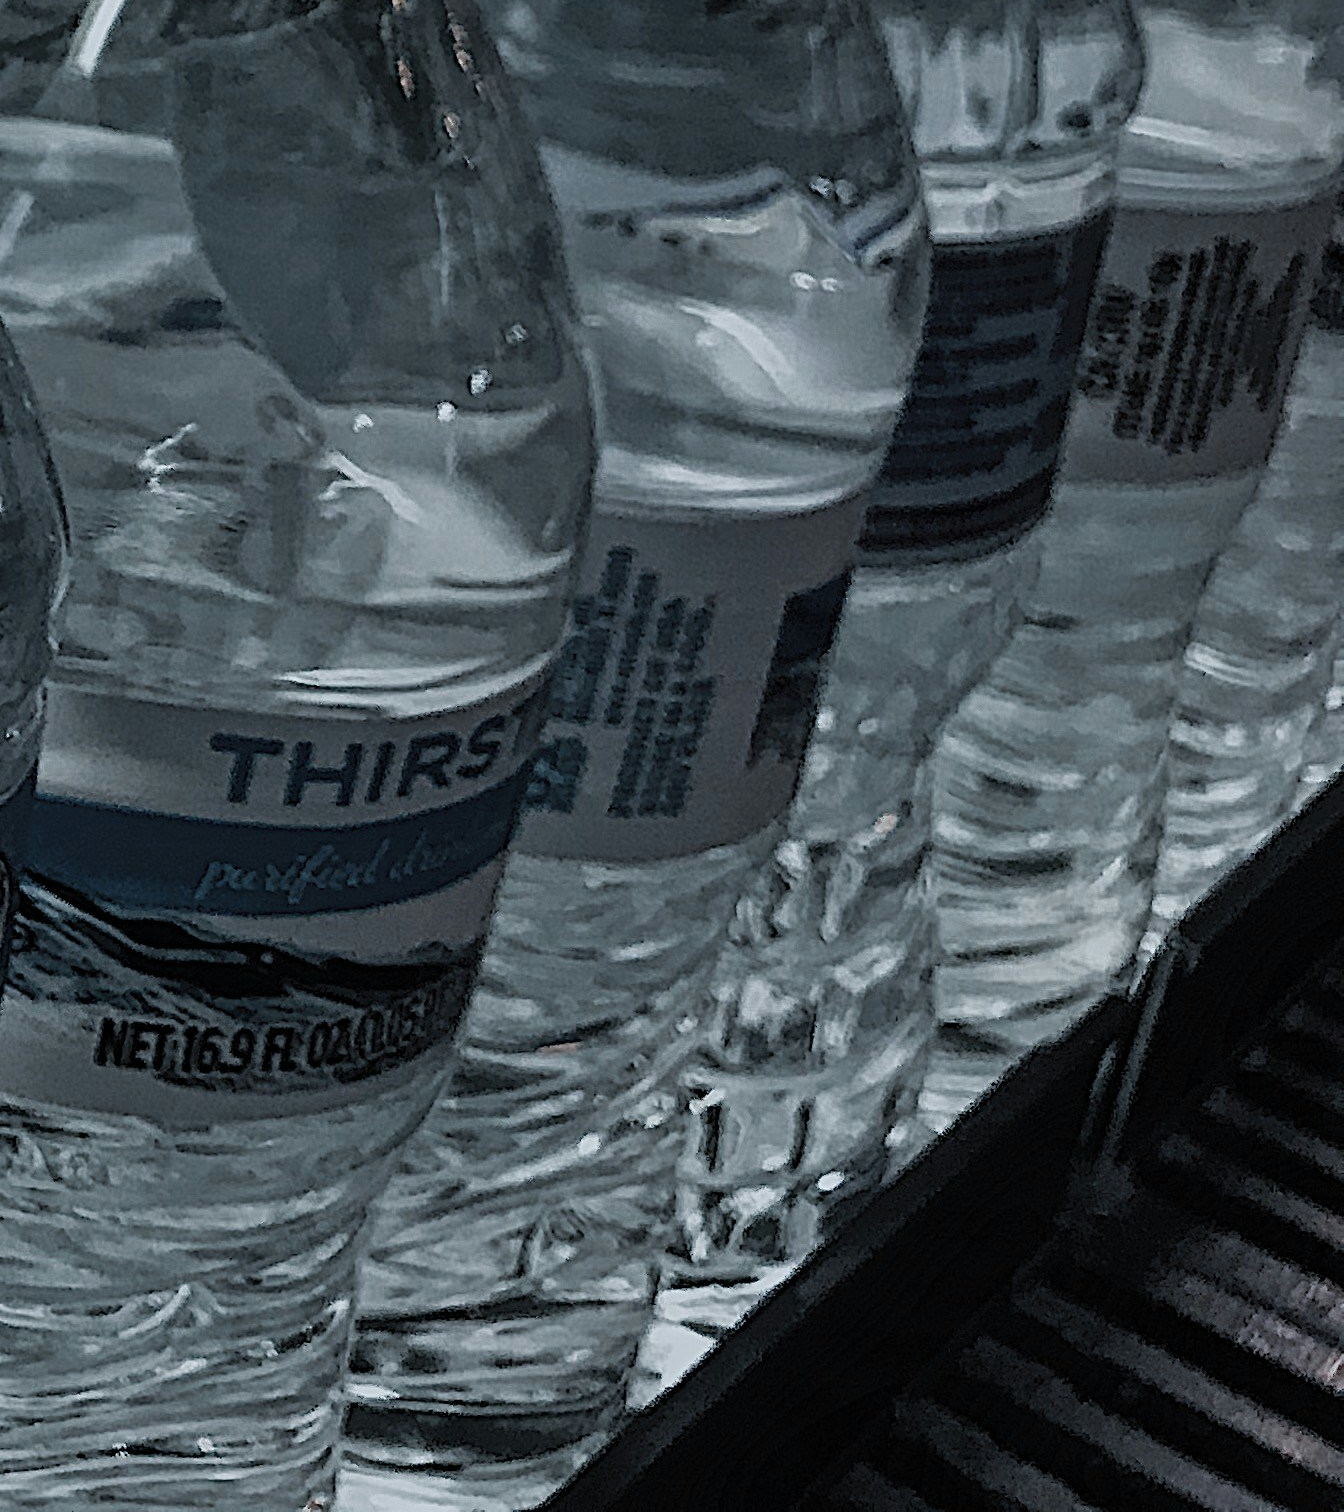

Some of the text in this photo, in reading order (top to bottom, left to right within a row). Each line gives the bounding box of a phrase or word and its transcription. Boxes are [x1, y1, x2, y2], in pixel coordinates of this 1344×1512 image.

[210, 714, 512, 806] THIRS
[194, 838, 392, 904] purified
[94, 1018, 176, 1069] NET
